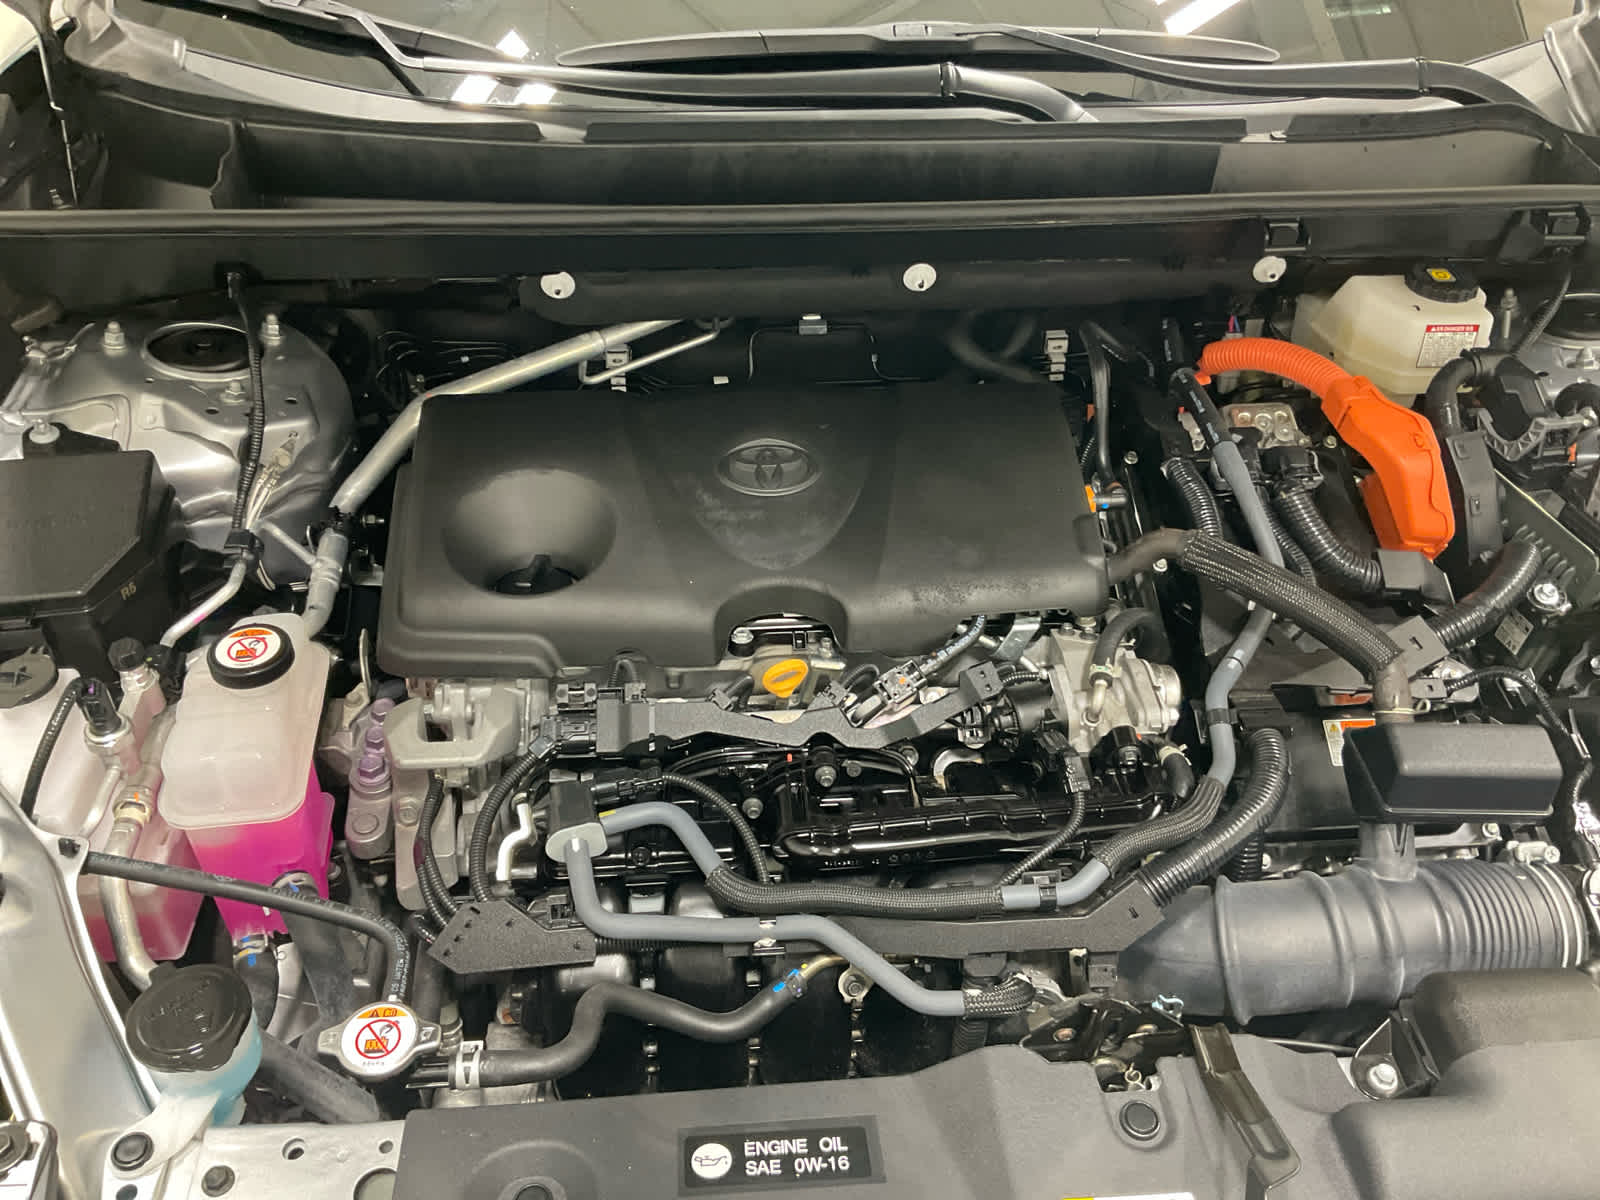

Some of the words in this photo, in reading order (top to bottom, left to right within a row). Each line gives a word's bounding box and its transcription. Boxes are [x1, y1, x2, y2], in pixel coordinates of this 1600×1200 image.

[744, 1138, 808, 1157] ENGINE
[819, 1136, 848, 1152] OIL
[745, 1159, 782, 1176] SAE
[794, 1156, 850, 1173] 0W-16
